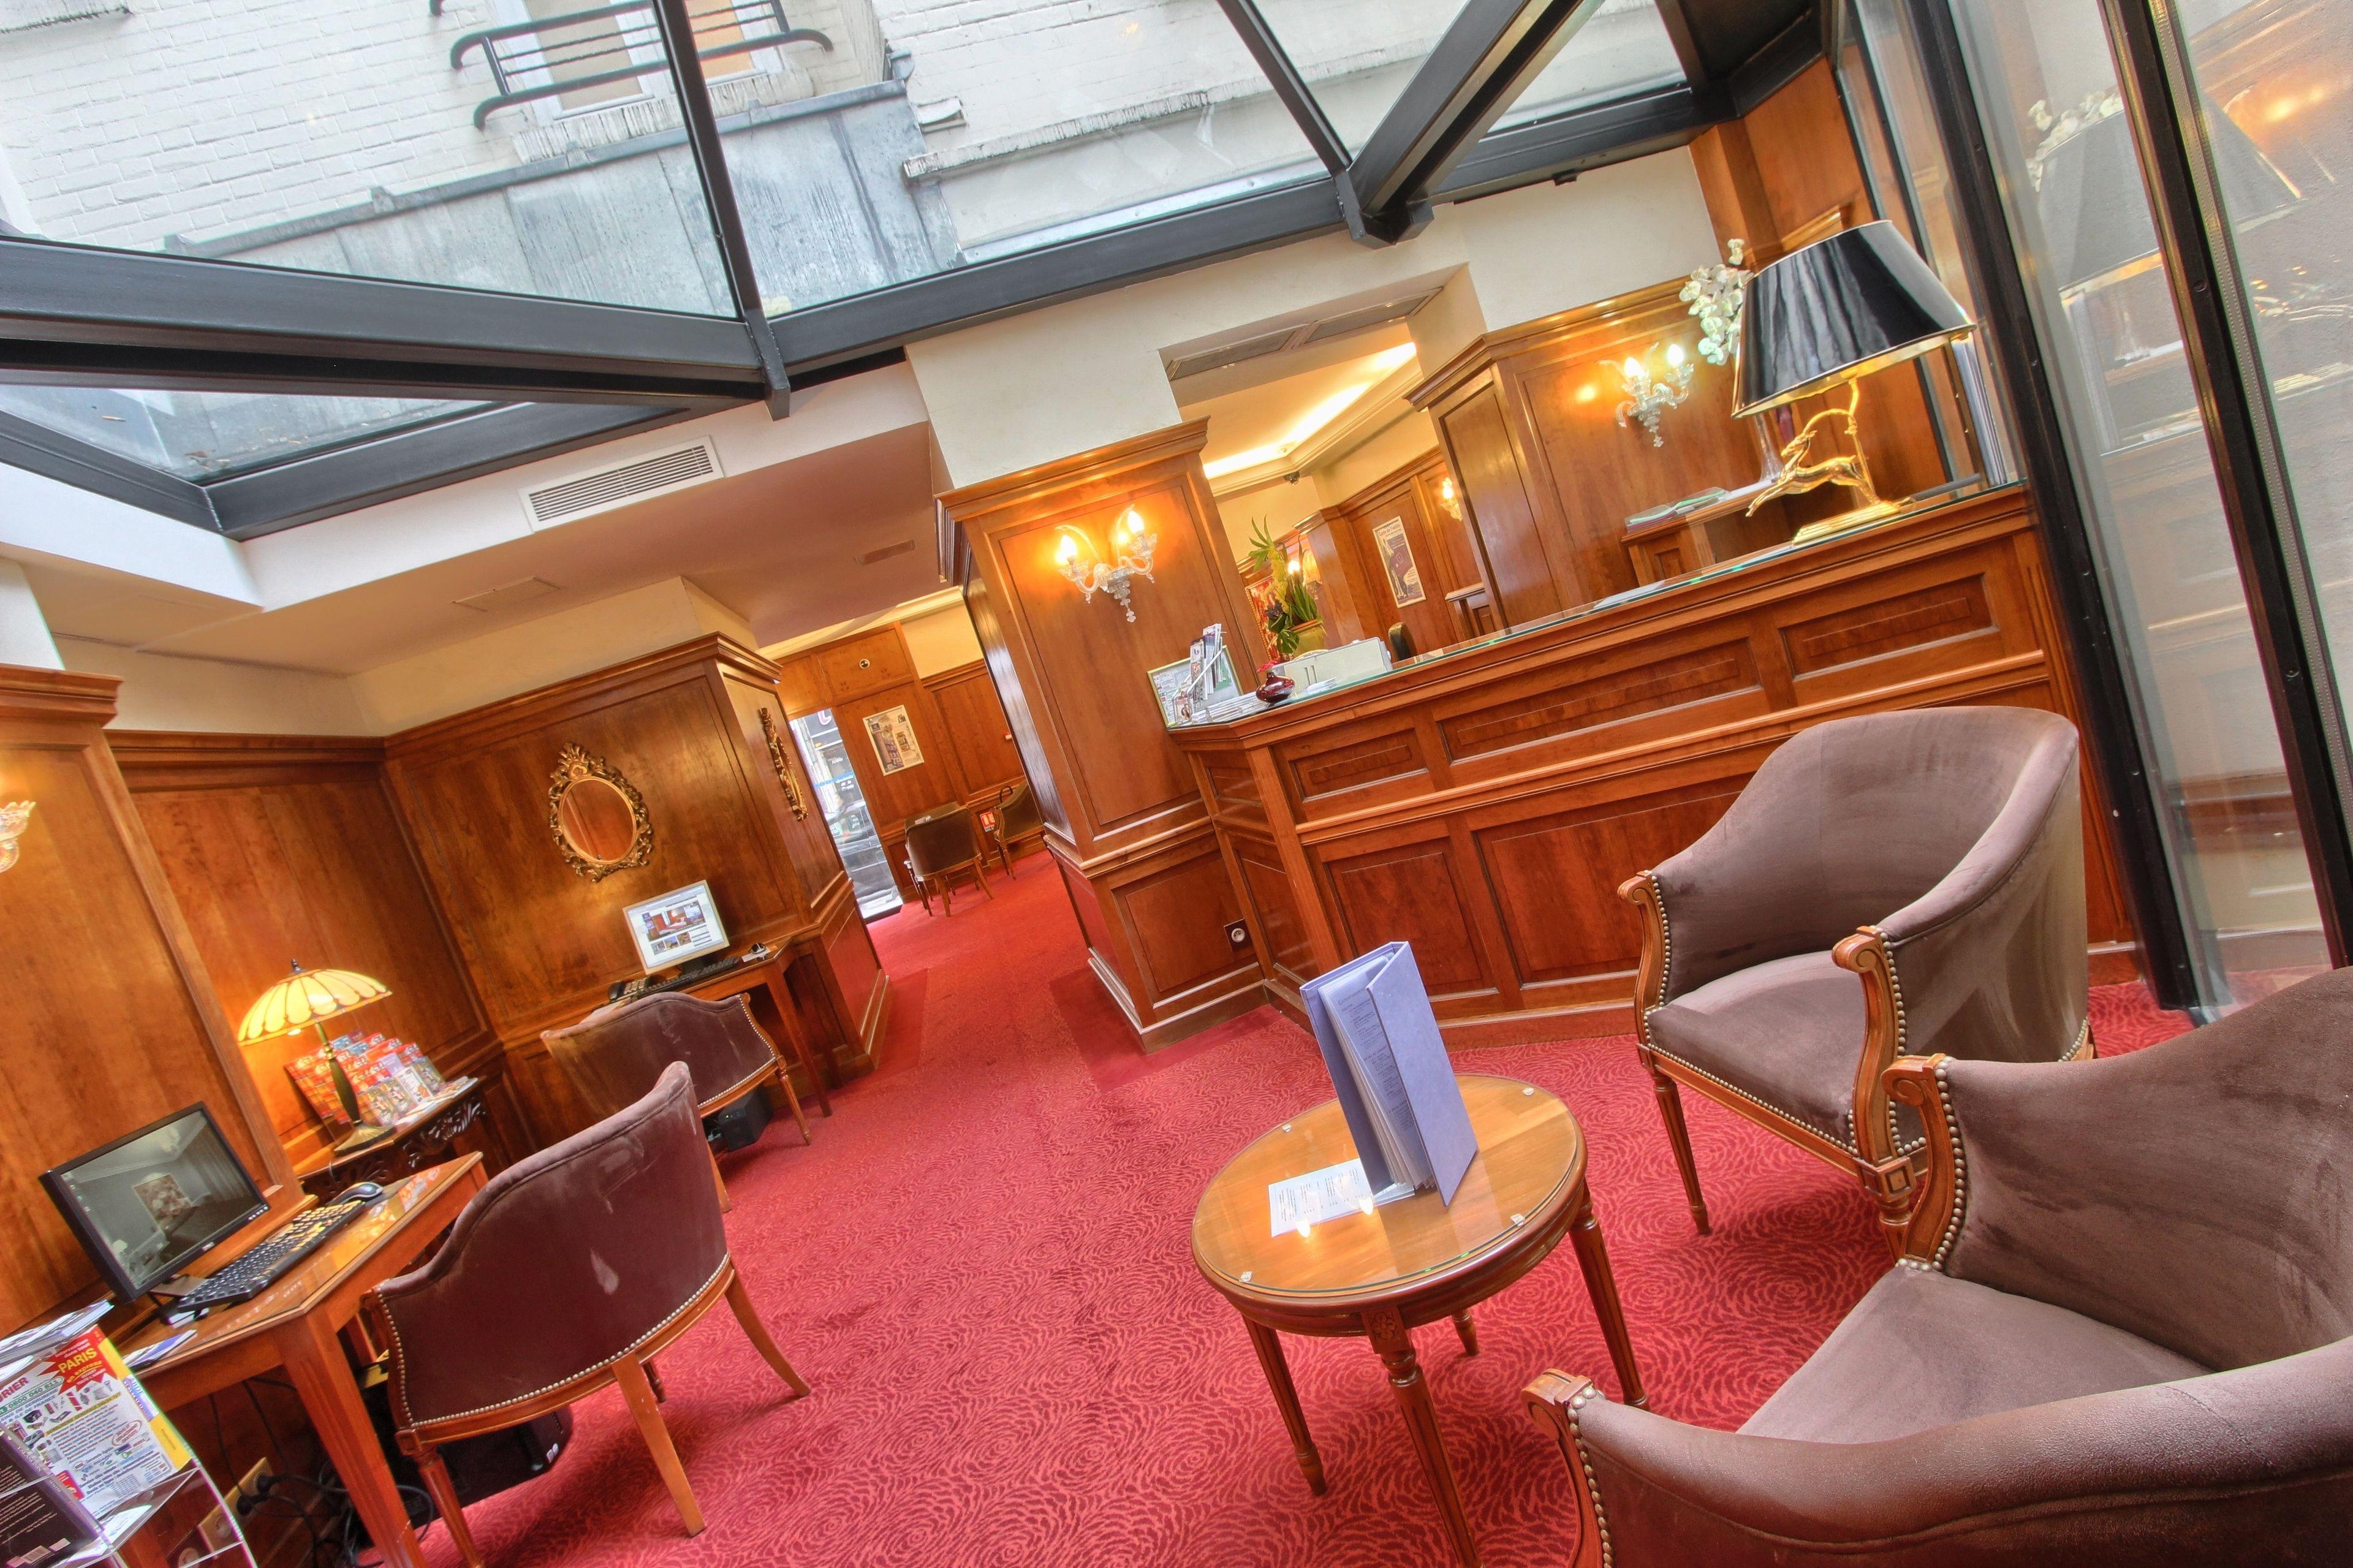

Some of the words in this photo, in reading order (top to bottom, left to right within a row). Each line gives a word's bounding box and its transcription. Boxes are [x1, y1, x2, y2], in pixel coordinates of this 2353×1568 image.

[55, 1338, 88, 1357] Intervention
[64, 1349, 77, 1358] dans
[77, 1342, 90, 1350] tout
[58, 1347, 97, 1373] PARIS
[74, 1360, 102, 1374] express
[9, 1396, 27, 1407] 0800
[29, 1388, 42, 1397] 040
